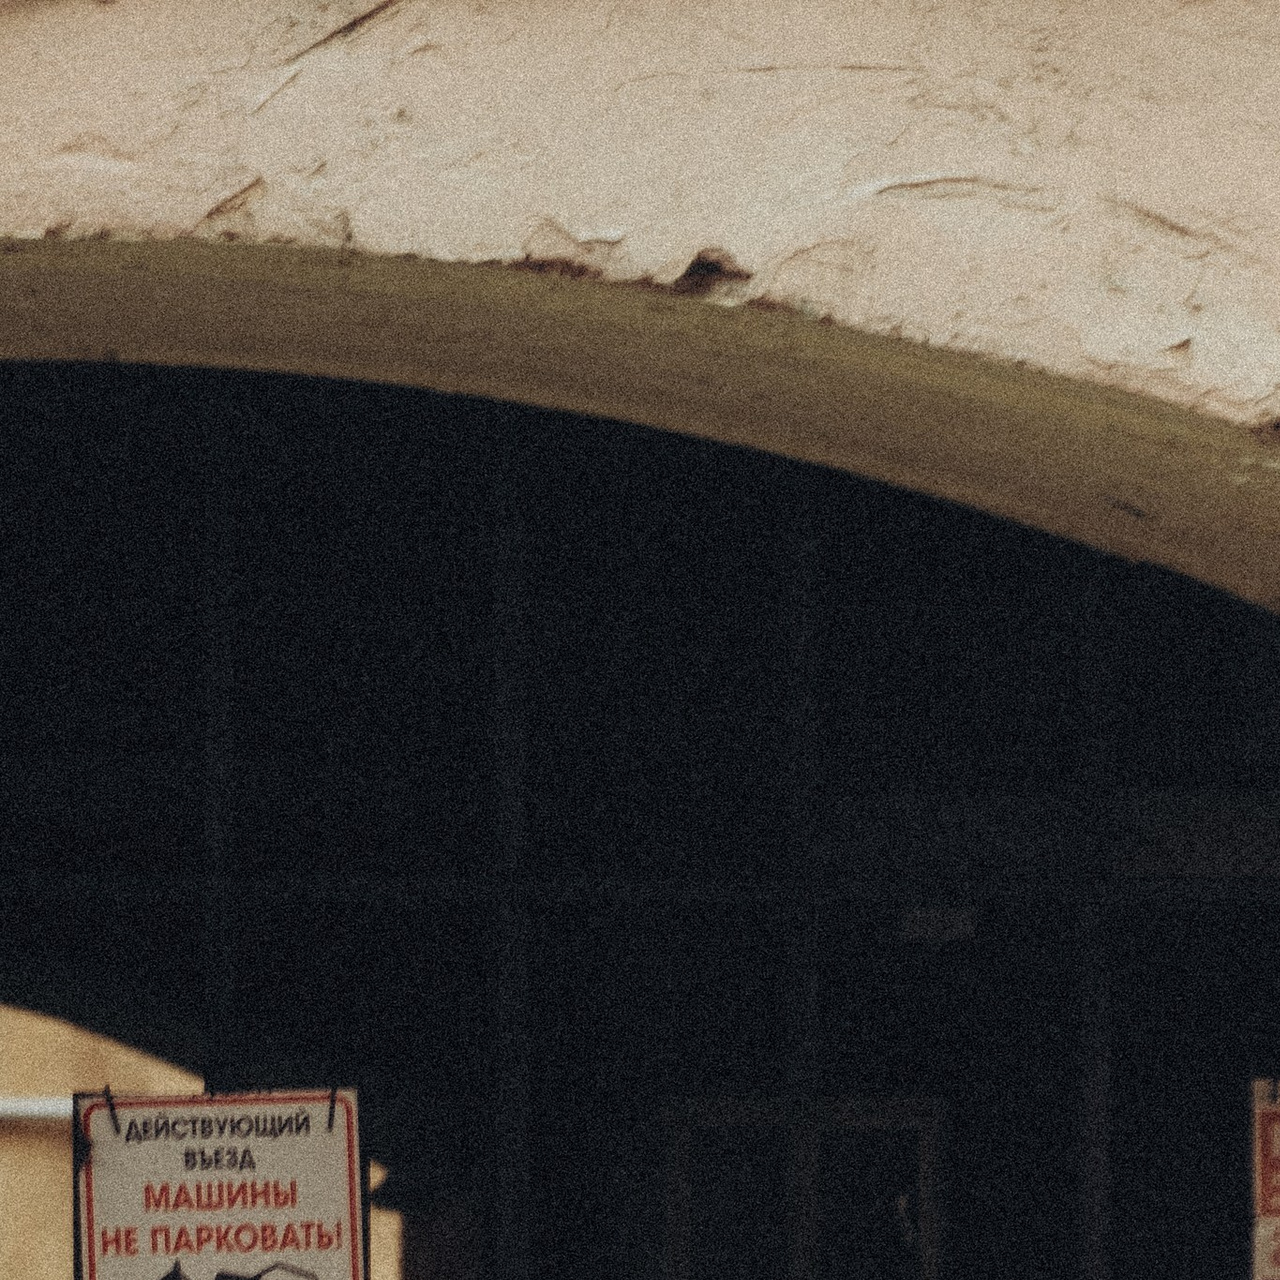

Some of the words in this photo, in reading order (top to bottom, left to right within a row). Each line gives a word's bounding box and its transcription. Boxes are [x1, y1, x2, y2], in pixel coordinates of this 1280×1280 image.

[125, 1111, 311, 1142] ДЕЙСТВУЮЩИЙ
[184, 1149, 257, 1172] ВЪЕЗД
[144, 1179, 298, 1213] МАШИНЫ
[101, 1226, 139, 1257] НЕ
